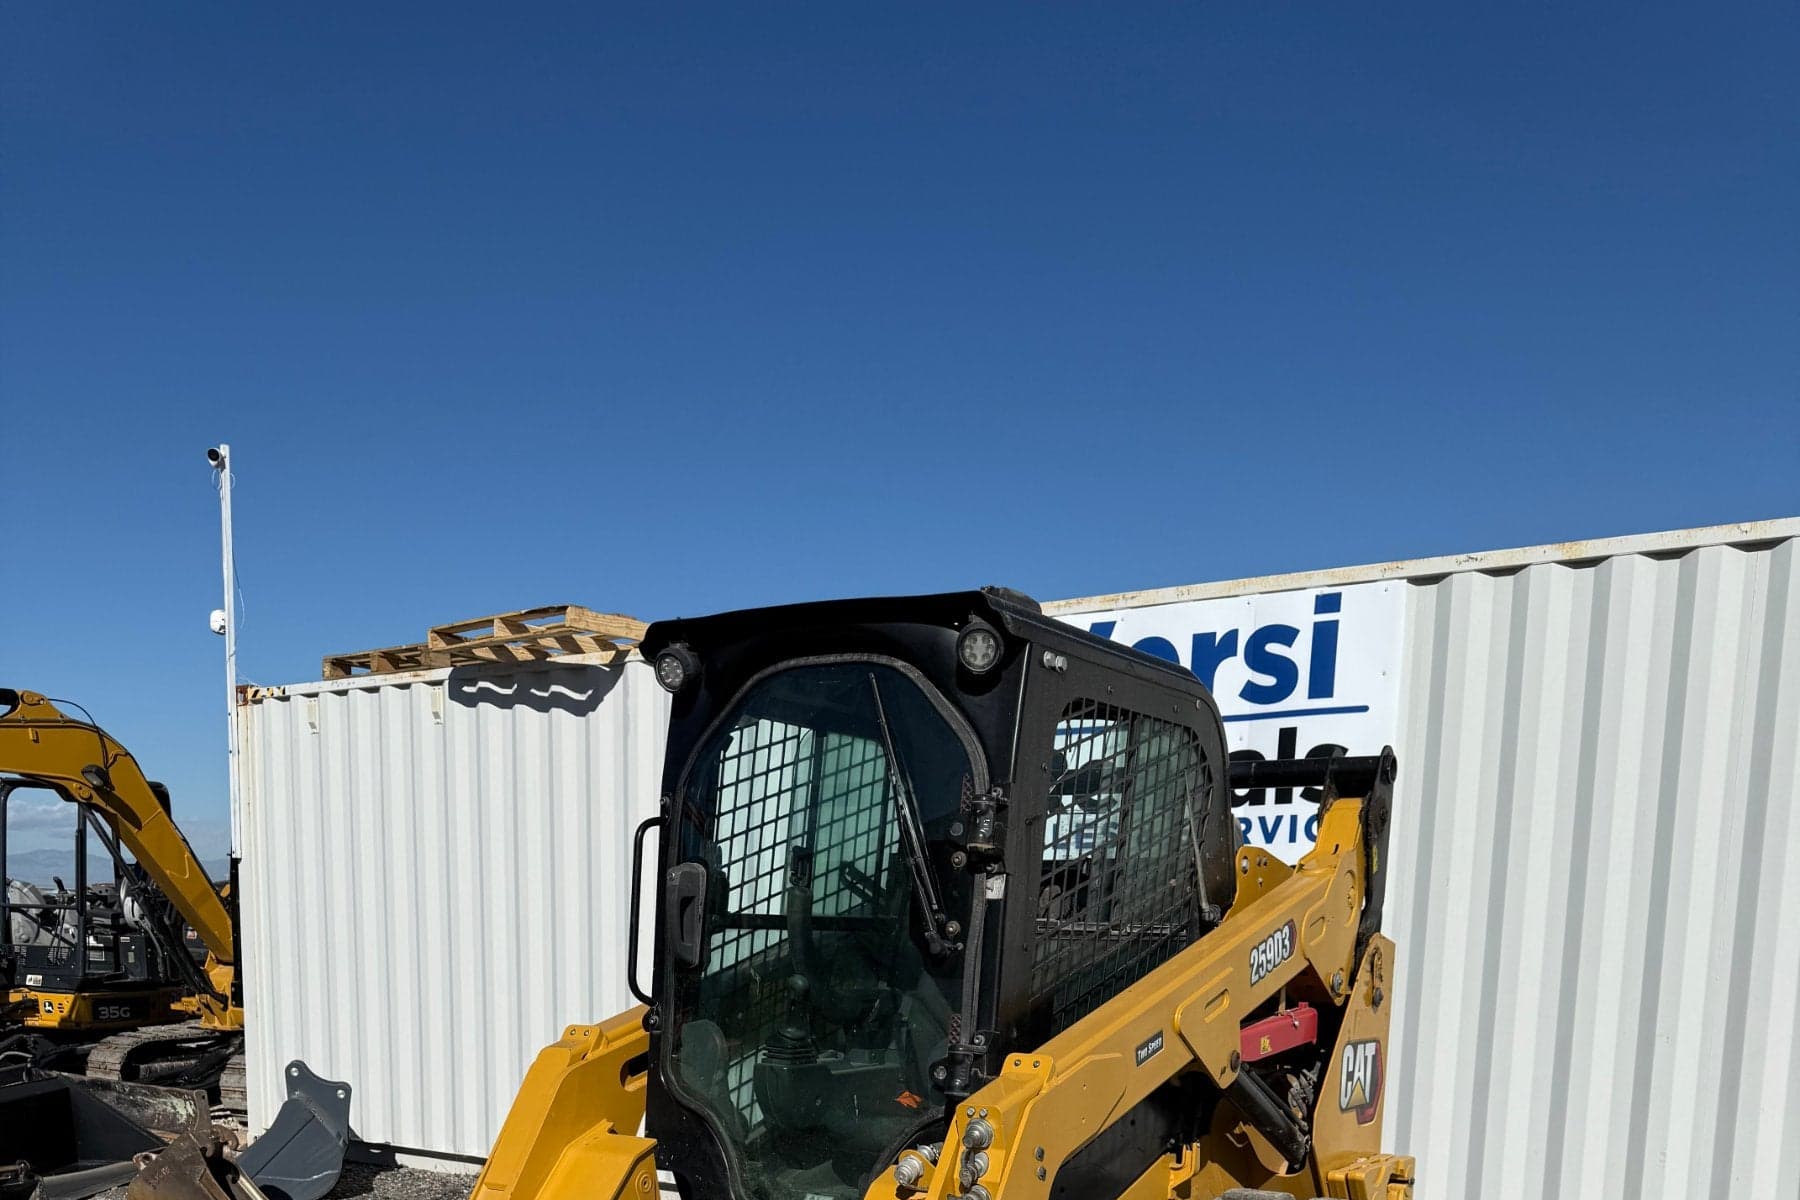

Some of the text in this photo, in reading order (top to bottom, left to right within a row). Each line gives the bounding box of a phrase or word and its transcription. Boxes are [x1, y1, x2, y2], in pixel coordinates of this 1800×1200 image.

[1250, 924, 1291, 985] 259D3
[98, 1006, 131, 1019] 35G
[1340, 1042, 1377, 1110] CAT
